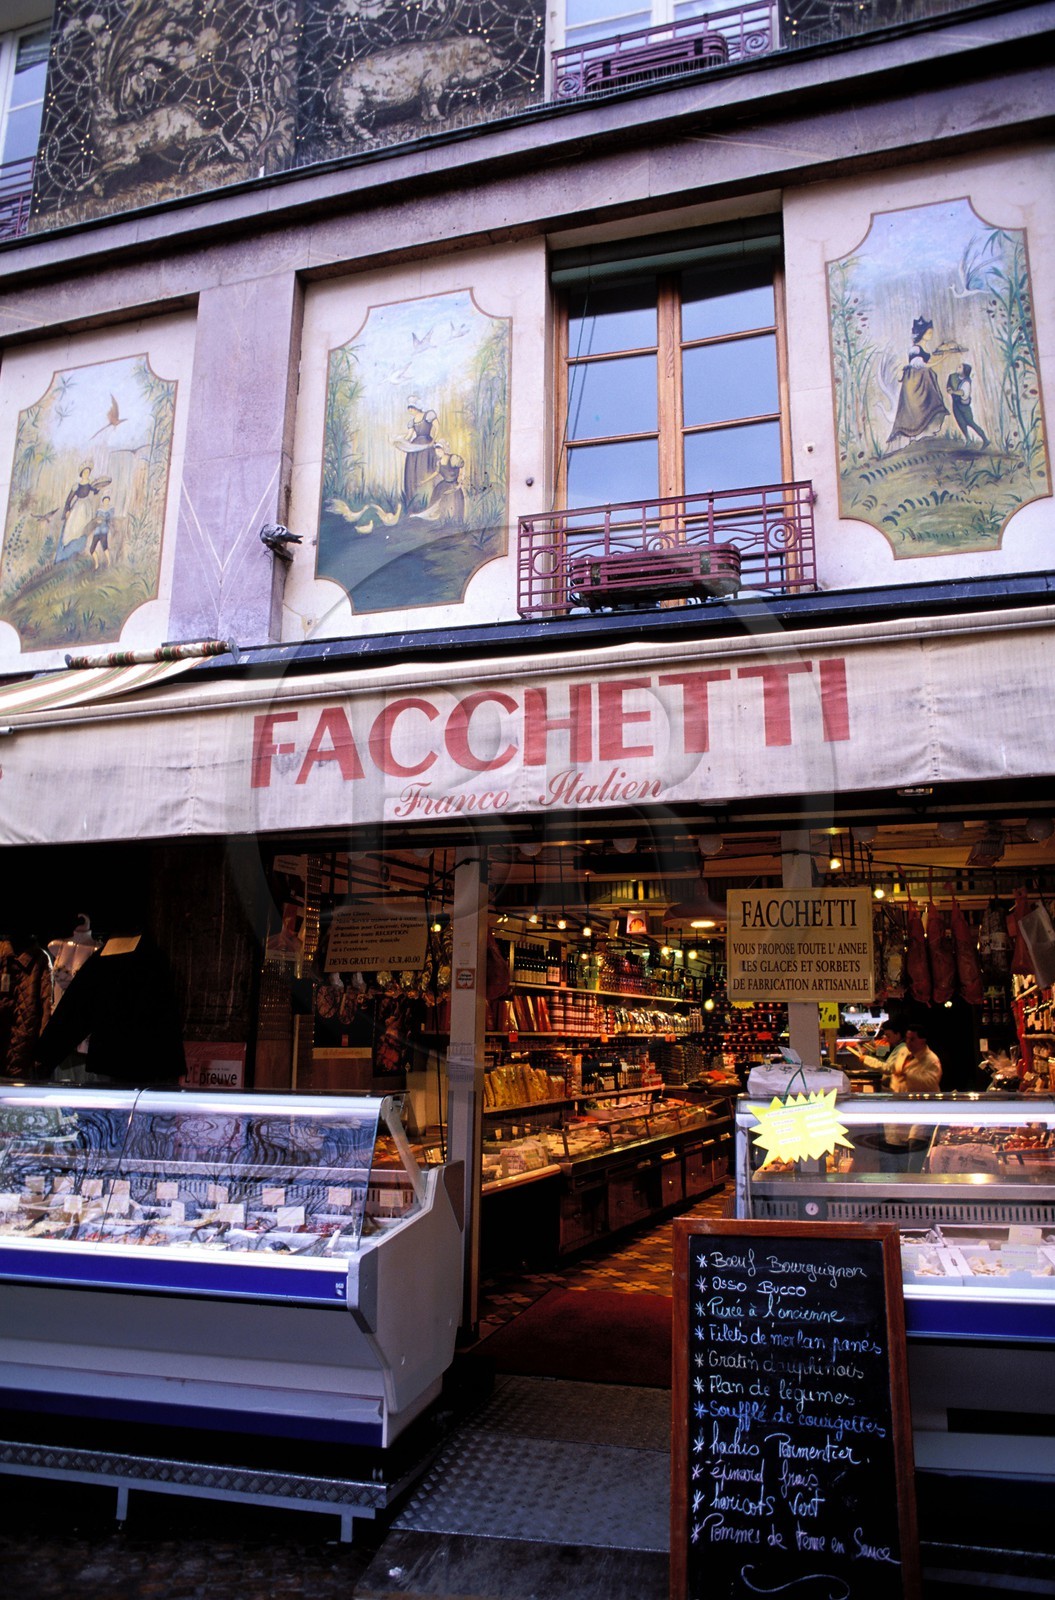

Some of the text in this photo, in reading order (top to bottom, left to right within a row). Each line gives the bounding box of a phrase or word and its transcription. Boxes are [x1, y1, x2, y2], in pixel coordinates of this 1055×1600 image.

[250, 657, 850, 789] FACCHETTI
[394, 768, 662, 817] Franco Italien
[741, 899, 857, 928] FACCHETTI
[375, 929, 409, 937] RECEPTION
[329, 957, 348, 966] DEVIS
[349, 955, 380, 966] GRATUIT
[733, 942, 868, 955] VOUS PROPOSE TOUTE L' ANNEE
[742, 960, 861, 973] LES GLACES ET SORBETS
[733, 978, 869, 991] DE FABRICATION ARTISANALE
[712, 1276, 806, 1296] Osso Bucco
[766, 1256, 867, 1288] Bourguignon
[707, 1296, 745, 1318] Purée
[749, 1302, 757, 1316] à
[709, 1323, 882, 1362] Filets de merlan panés
[708, 1350, 759, 1371] Gratin
[710, 1374, 855, 1413] Flan de légumes
[710, 1400, 767, 1432] Soufflé
[774, 1405, 794, 1424] de
[709, 1420, 760, 1455] hachis
[778, 1459, 819, 1498] frais
[767, 1523, 788, 1550] de
[831, 1537, 845, 1554] en
